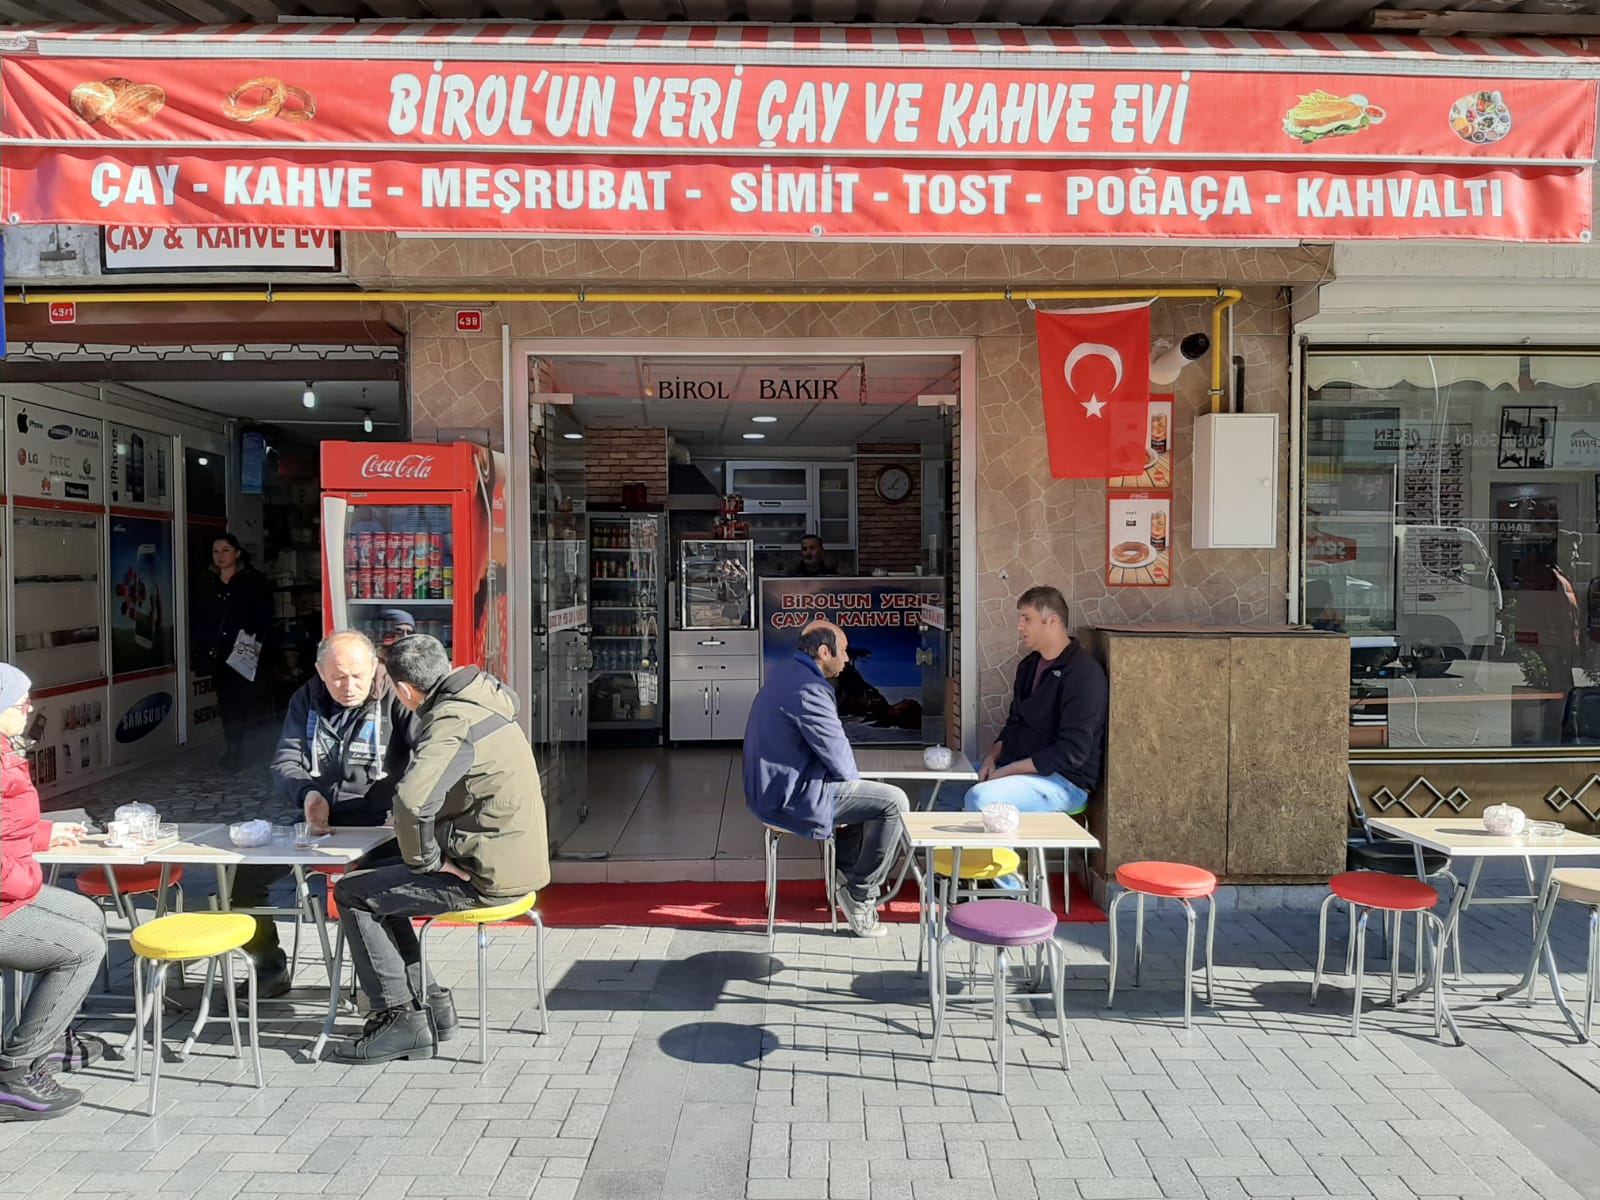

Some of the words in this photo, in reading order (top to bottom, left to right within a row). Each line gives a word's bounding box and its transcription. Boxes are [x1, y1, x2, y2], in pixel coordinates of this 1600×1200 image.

[388, 59, 618, 141] BİROL'UN
[632, 64, 744, 146] YERİ
[757, 80, 851, 148] ÇAY
[866, 82, 925, 144] VE
[937, 83, 1096, 147] KAHVE
[1111, 70, 1193, 147] EVİ
[91, 162, 180, 209] ÇAY
[224, 166, 373, 209] KAHVE
[422, 168, 673, 215] MEŞRUBAT
[730, 164, 861, 215] SİMİT
[903, 174, 1013, 216] TOST
[1067, 168, 1253, 222] POĞAÇA
[1297, 178, 1505, 220] KAHVALTI
[106, 225, 153, 253] ÇAY
[163, 226, 184, 249] &
[196, 227, 285, 249] KAHVE
[658, 376, 730, 400] BİROL
[759, 379, 840, 401] BAKIR
[74, 427, 99, 440] NOKIA
[28, 453, 38, 464] LG
[361, 453, 435, 479] Coca-Cola
[771, 612, 807, 629] ÇAY
[837, 612, 901, 627] KAHVE
[121, 703, 168, 731] SAMSUNG
